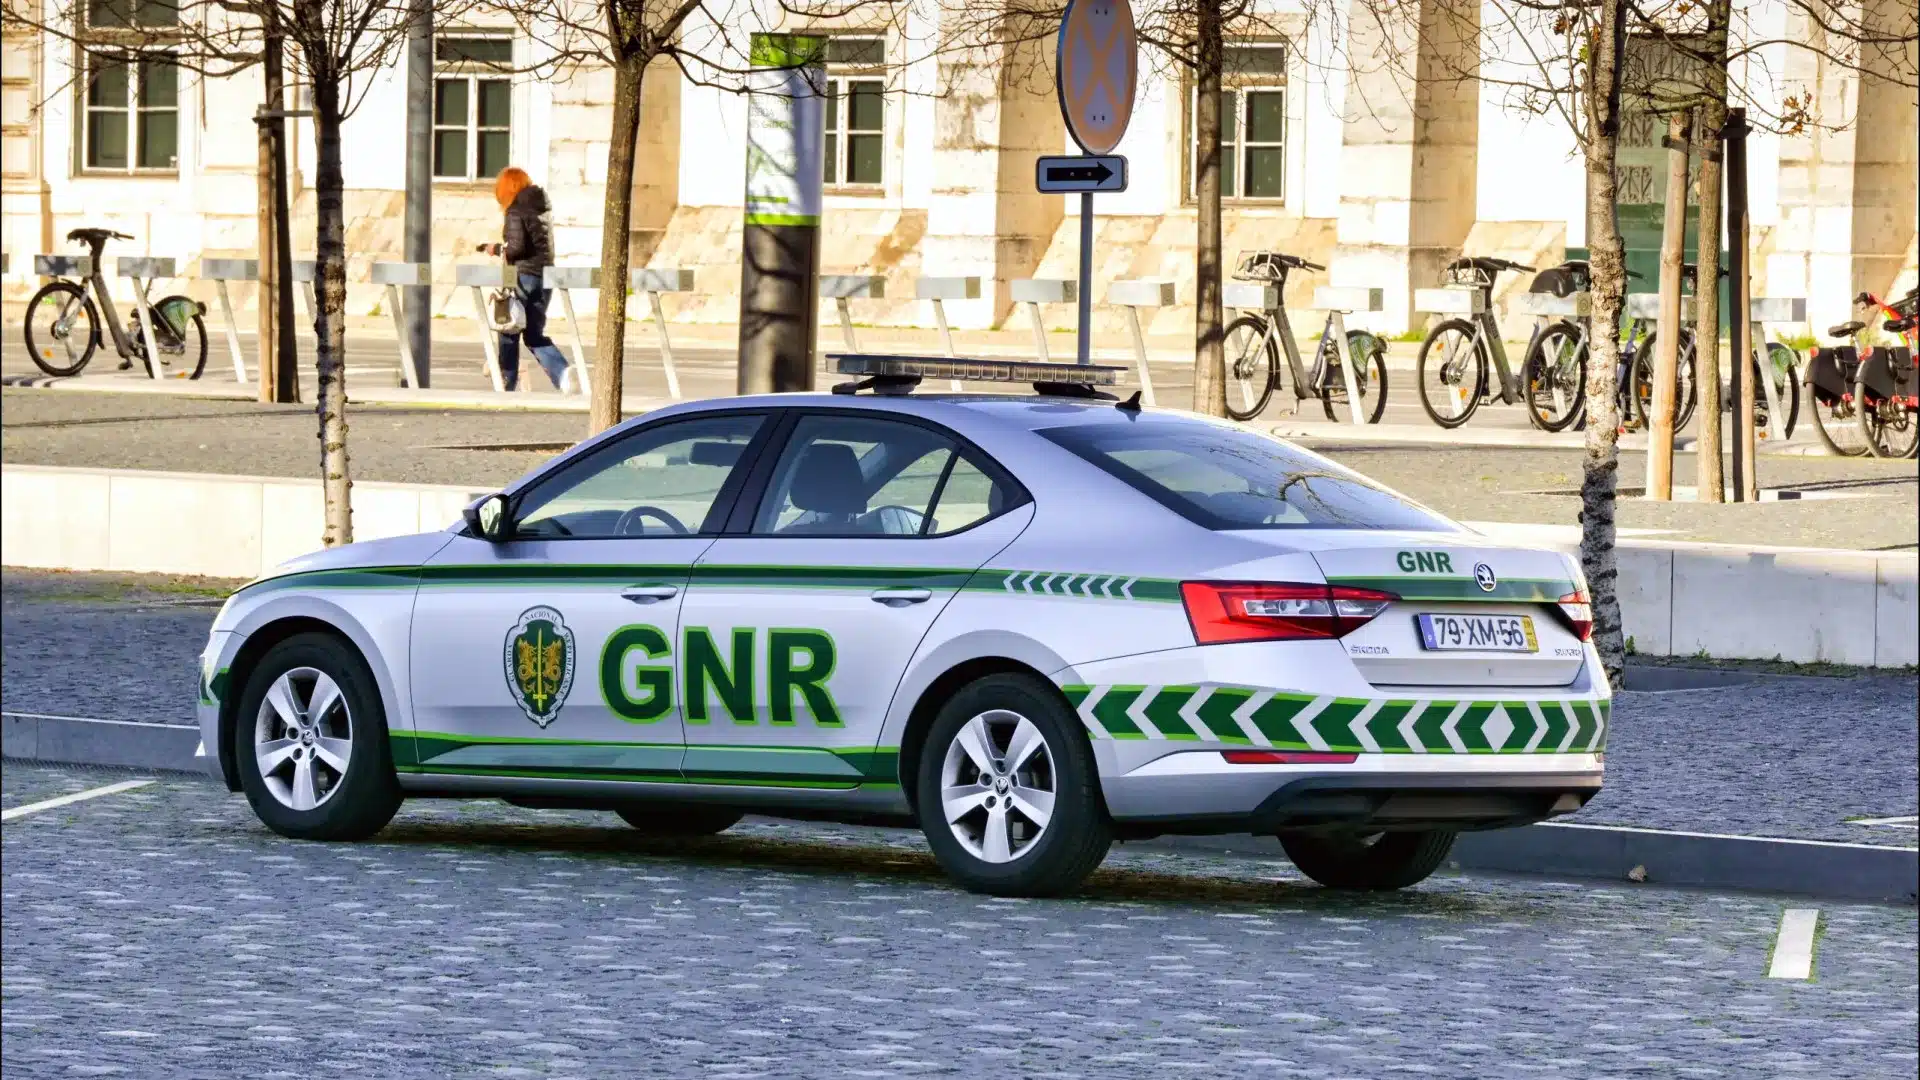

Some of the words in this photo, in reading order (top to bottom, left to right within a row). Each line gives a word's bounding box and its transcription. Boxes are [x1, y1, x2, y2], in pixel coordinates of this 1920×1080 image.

[1396, 551, 1455, 574] GNR
[525, 610, 558, 623] NACIONAL
[599, 623, 845, 729] GNR
